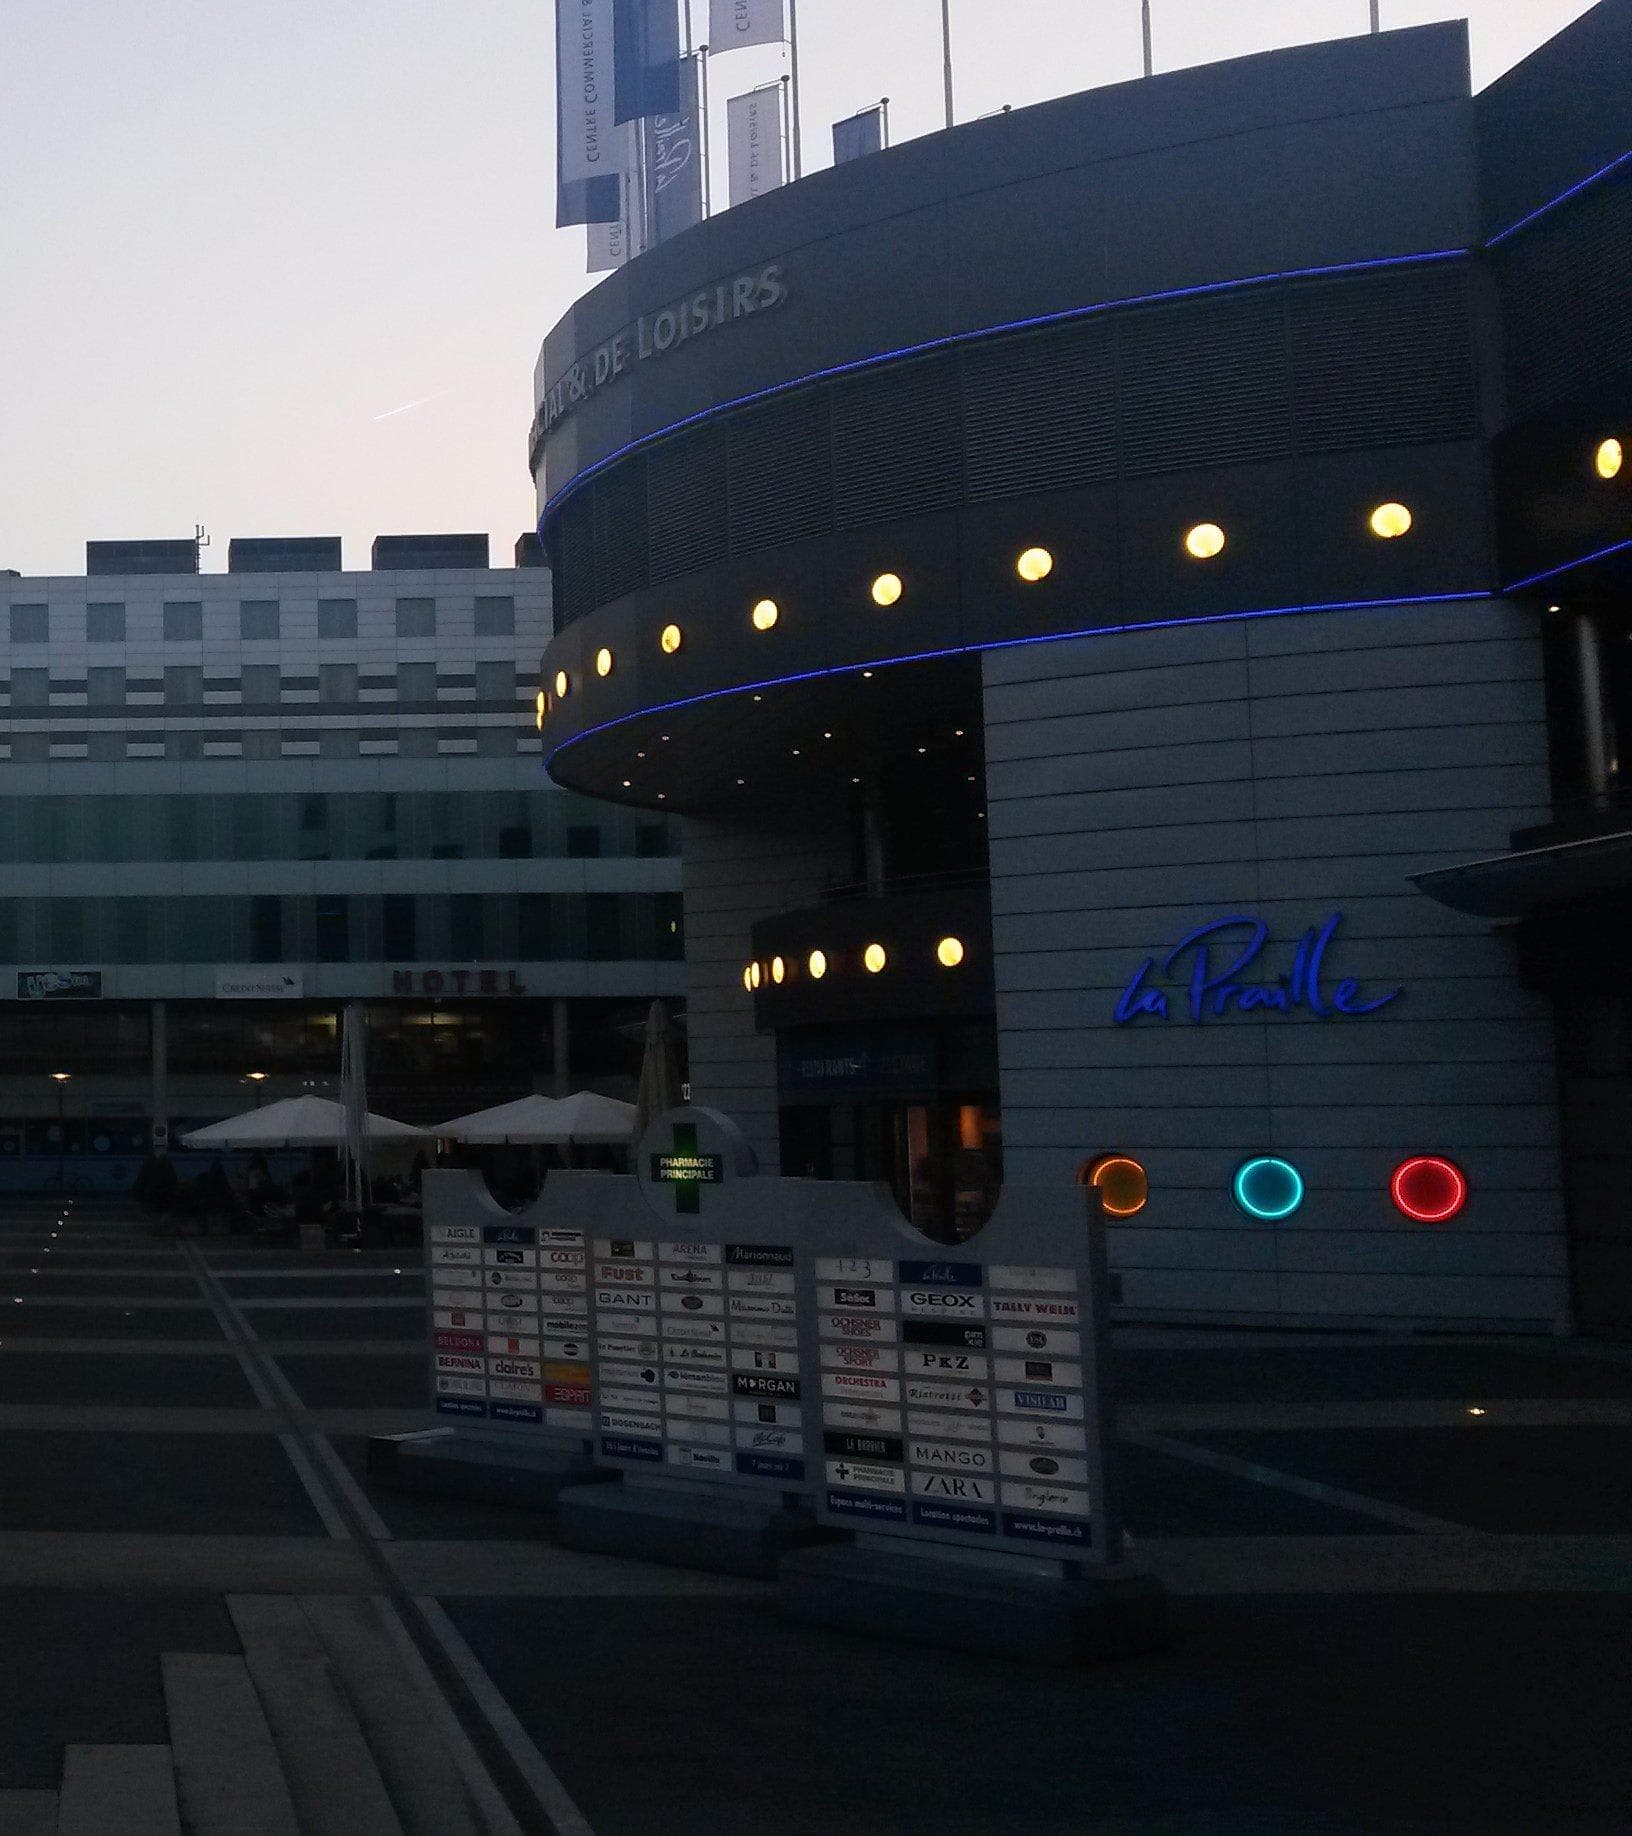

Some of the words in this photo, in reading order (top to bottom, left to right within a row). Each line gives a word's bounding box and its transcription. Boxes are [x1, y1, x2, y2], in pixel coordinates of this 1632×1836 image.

[595, 335, 625, 386] DE
[637, 264, 783, 360] LOISIRS
[392, 969, 525, 994] HOTEL
[659, 1157, 715, 1168] PHARMACIE
[659, 1168, 715, 1180] PRINCIPALE
[447, 1228, 475, 1239] AIGLE
[598, 1292, 652, 1306] GANT
[910, 1293, 976, 1308] GEOX
[993, 1302, 1032, 1313] TALLY
[831, 1317, 881, 1331] OCHSNER
[836, 1347, 880, 1360] OCHSNER
[438, 1357, 481, 1370] BERNINA
[922, 1353, 970, 1370] PKZ
[835, 1376, 887, 1388] ORCHESTRA
[915, 1447, 986, 1467] MANGO
[924, 1476, 984, 1499] ZARA
